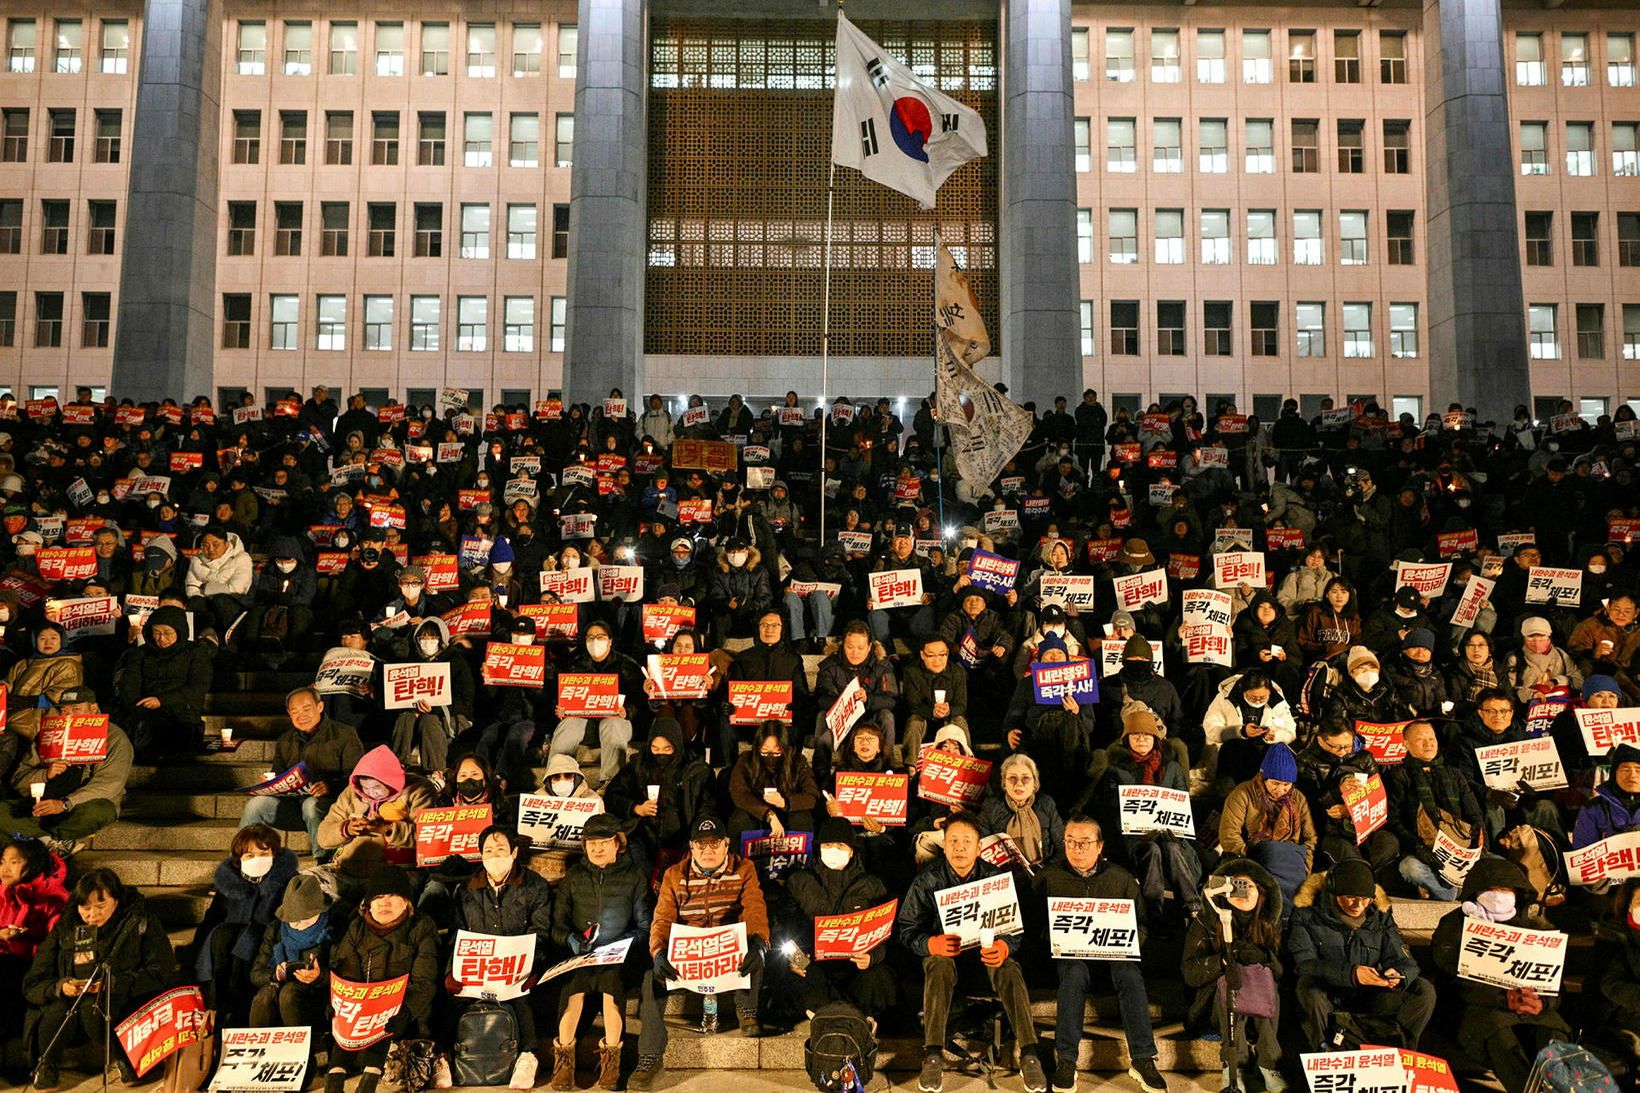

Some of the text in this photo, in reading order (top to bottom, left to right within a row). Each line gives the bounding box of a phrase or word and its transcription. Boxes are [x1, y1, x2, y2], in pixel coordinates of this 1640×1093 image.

[38, 549, 92, 558] 내란수괴 윤석열
[1217, 554, 1242, 566] 윤석열
[40, 559, 95, 577] 즉각 탄핵!
[975, 555, 1017, 574] 내란행위
[1222, 562, 1260, 582] 탄핵!
[1402, 567, 1447, 579] 윤석열은
[428, 573, 457, 584] 탄핵!
[543, 573, 568, 583] 윤석열
[873, 574, 897, 586] 윤석열
[971, 569, 1015, 588] 즉각수사!
[1119, 577, 1142, 590] 윤석열
[1530, 570, 1580, 579] 내란수괴 윤석열
[548, 577, 588, 597] 탄핵!
[602, 577, 638, 594] 탄핵!
[793, 583, 818, 591] 윤석열
[877, 580, 917, 602] 탄핵!
[1124, 580, 1162, 605] 탄핵!
[1530, 578, 1578, 599] 즉각 체포!
[1042, 586, 1092, 604] 즉각 체포!
[1184, 591, 1230, 604] 내란수괴 윤석열
[61, 600, 109, 618] 윤석열은
[521, 606, 575, 615] 내란수괴 윤석열
[645, 607, 694, 617] 내란수괴 윤석열
[1184, 601, 1230, 625] 즉각 체포!
[458, 618, 490, 631] 탄핵!
[545, 623, 578, 637] 탄핵!
[645, 615, 671, 628] 즉각
[1185, 625, 1212, 637] 윤석열
[488, 645, 543, 656] 내란수괴 윤석열
[1188, 637, 1228, 657] 탄핵!
[486, 654, 543, 679] 즉각 탄핵!
[682, 655, 706, 665] 윤석열
[335, 676, 366, 686] 체포!
[389, 667, 419, 681] 윤석열
[560, 676, 616, 685] 내란수괴 윤석열
[673, 674, 704, 689] 탄핵!
[1039, 666, 1088, 683] 내란행위
[393, 678, 442, 699] 탄핵!
[559, 686, 617, 708] 즉각 탄핵!
[731, 684, 789, 693] 내란수괴 윤석열
[1040, 678, 1093, 698] 즉각수사!
[732, 694, 789, 717] 즉각 탄핵!
[74, 717, 105, 727] 윤석열
[1583, 713, 1611, 725] 윤석열
[1357, 724, 1393, 736] 내란수괴
[1592, 722, 1640, 747] 탄핵!
[66, 738, 104, 754] 탄핵!
[1363, 736, 1391, 750] 즉각
[1479, 741, 1551, 762] 내란수괴 윤석열
[925, 752, 992, 773] 내란수괴 윤석열
[1485, 758, 1559, 781] 즉각 체포!
[838, 775, 905, 788] 내란수괴 윤석열
[923, 763, 984, 801] 즉각 탄핵!
[837, 787, 904, 815] 즉각 탄핵!
[1121, 787, 1187, 802] 내란수괴 윤석열
[521, 797, 596, 812] 내란수괴 윤석열
[1122, 799, 1191, 828] 즉각 체포!
[1351, 801, 1370, 822] 즉각
[419, 808, 489, 823] 내란수괴 윤석열
[521, 810, 558, 828] 즉각
[419, 824, 452, 843] 즉각
[748, 836, 805, 856] 내란행위
[1438, 834, 1474, 858] 내란수괴
[1571, 846, 1607, 865] 윤석열
[1580, 846, 1640, 882] 탄핵!
[939, 877, 1010, 905] 내란수괴 윤석열
[817, 904, 892, 929] 내란수괴 윤석열
[945, 901, 1017, 929] 즉각 체포!
[1051, 901, 1131, 914] 내란수괴 윤석열
[817, 927, 856, 943] 즉각
[854, 919, 892, 950] 탄핵!
[1051, 915, 1136, 948] 즉각 체포!
[1466, 921, 1562, 949] 내란수괴 윤석열
[458, 940, 494, 955] 윤석열
[672, 931, 739, 961] 윤석열은
[1463, 936, 1515, 962] 즉각
[1504, 959, 1560, 982] 체포!
[462, 955, 525, 986] 탄핵!
[370, 981, 403, 996] 윤석열
[126, 1003, 172, 1052] 탄핵!
[351, 1007, 400, 1036] 탄핵!
[225, 1031, 307, 1045] 내란수괴 윤석열
[221, 1048, 303, 1082] 즉각 체포!
[1307, 1054, 1395, 1071] 내란수괴 윤석열
[1416, 1057, 1446, 1073] 윤석열
